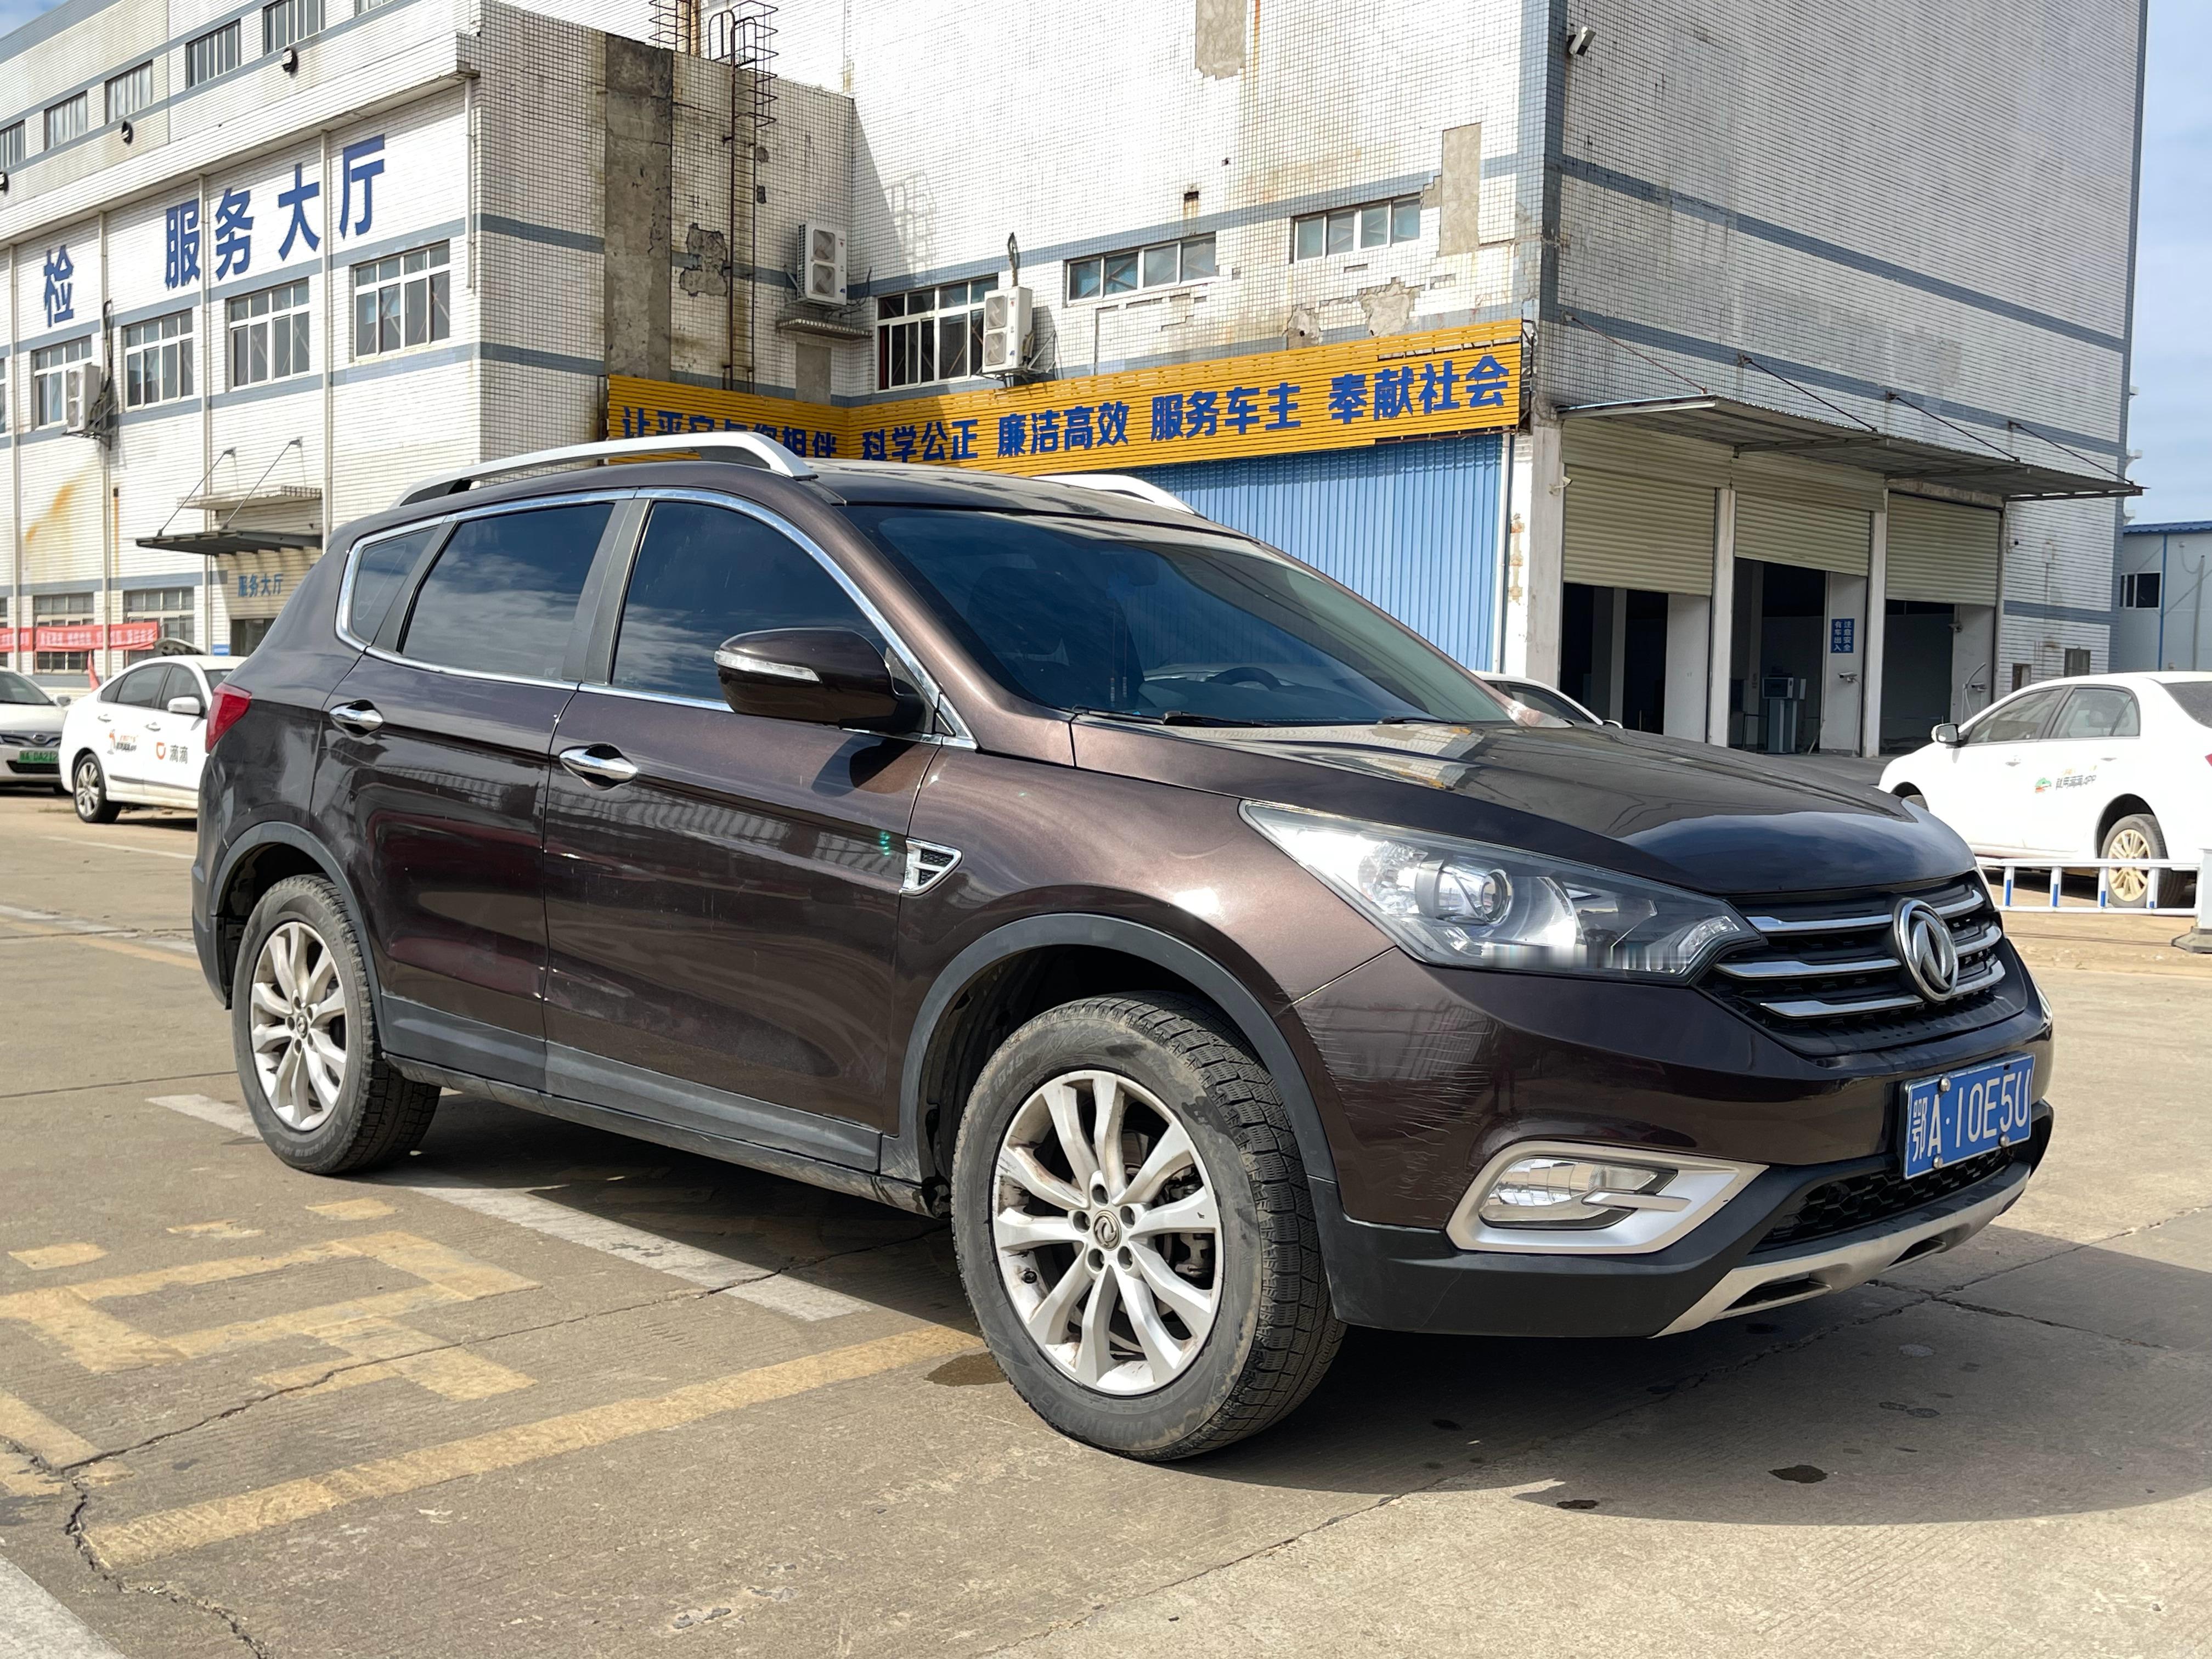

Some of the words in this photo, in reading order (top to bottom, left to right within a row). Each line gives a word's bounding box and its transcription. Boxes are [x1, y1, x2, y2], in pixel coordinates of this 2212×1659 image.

[43, 244, 75, 328] 检
[165, 133, 385, 290] 服务大厅
[862, 419, 979, 463] 科学公正
[997, 401, 1130, 459] 廉洁高效
[1150, 382, 1301, 442] 服务车主
[1328, 355, 1510, 425] 奉献社会
[238, 572, 284, 597] 服务大厅
